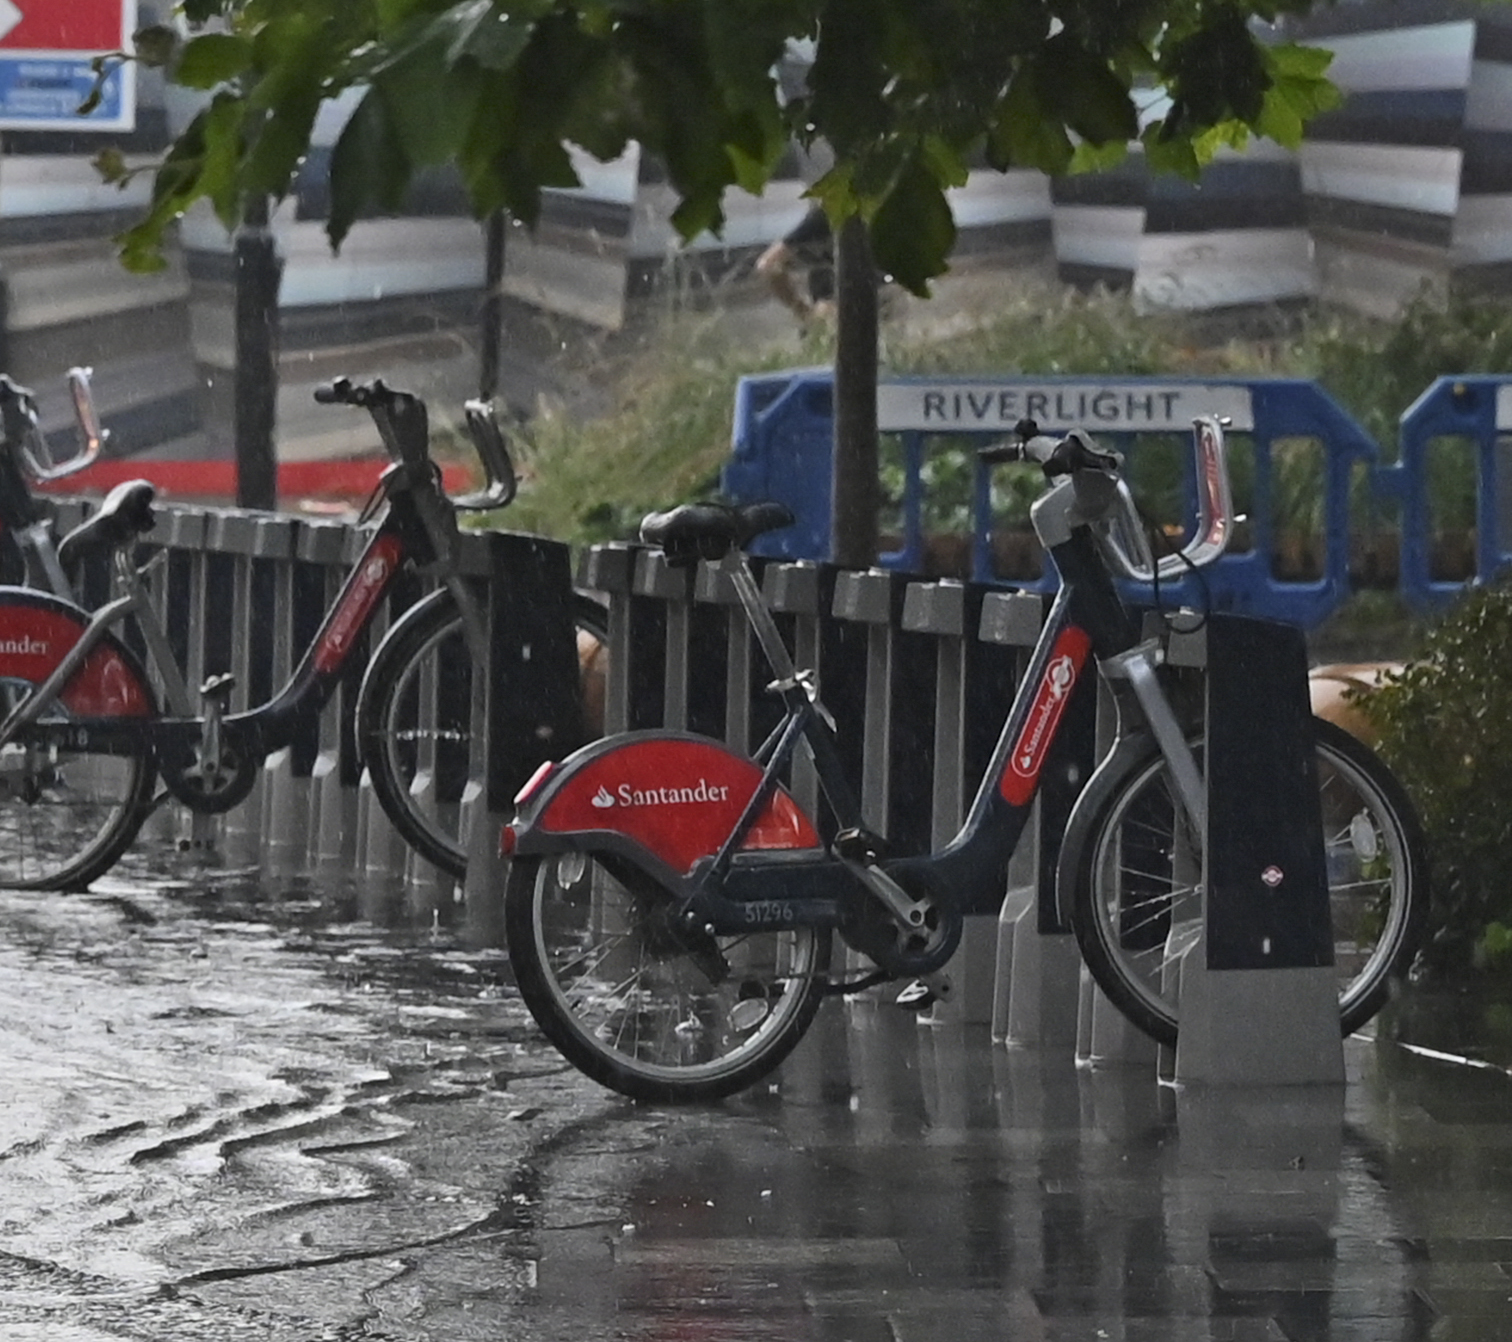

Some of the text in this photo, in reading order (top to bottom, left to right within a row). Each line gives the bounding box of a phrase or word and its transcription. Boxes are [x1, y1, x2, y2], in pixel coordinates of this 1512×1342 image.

[922, 390, 1181, 421] RIVERLIGHT
[1023, 696, 1055, 755] Santander
[618, 777, 729, 807] Santander
